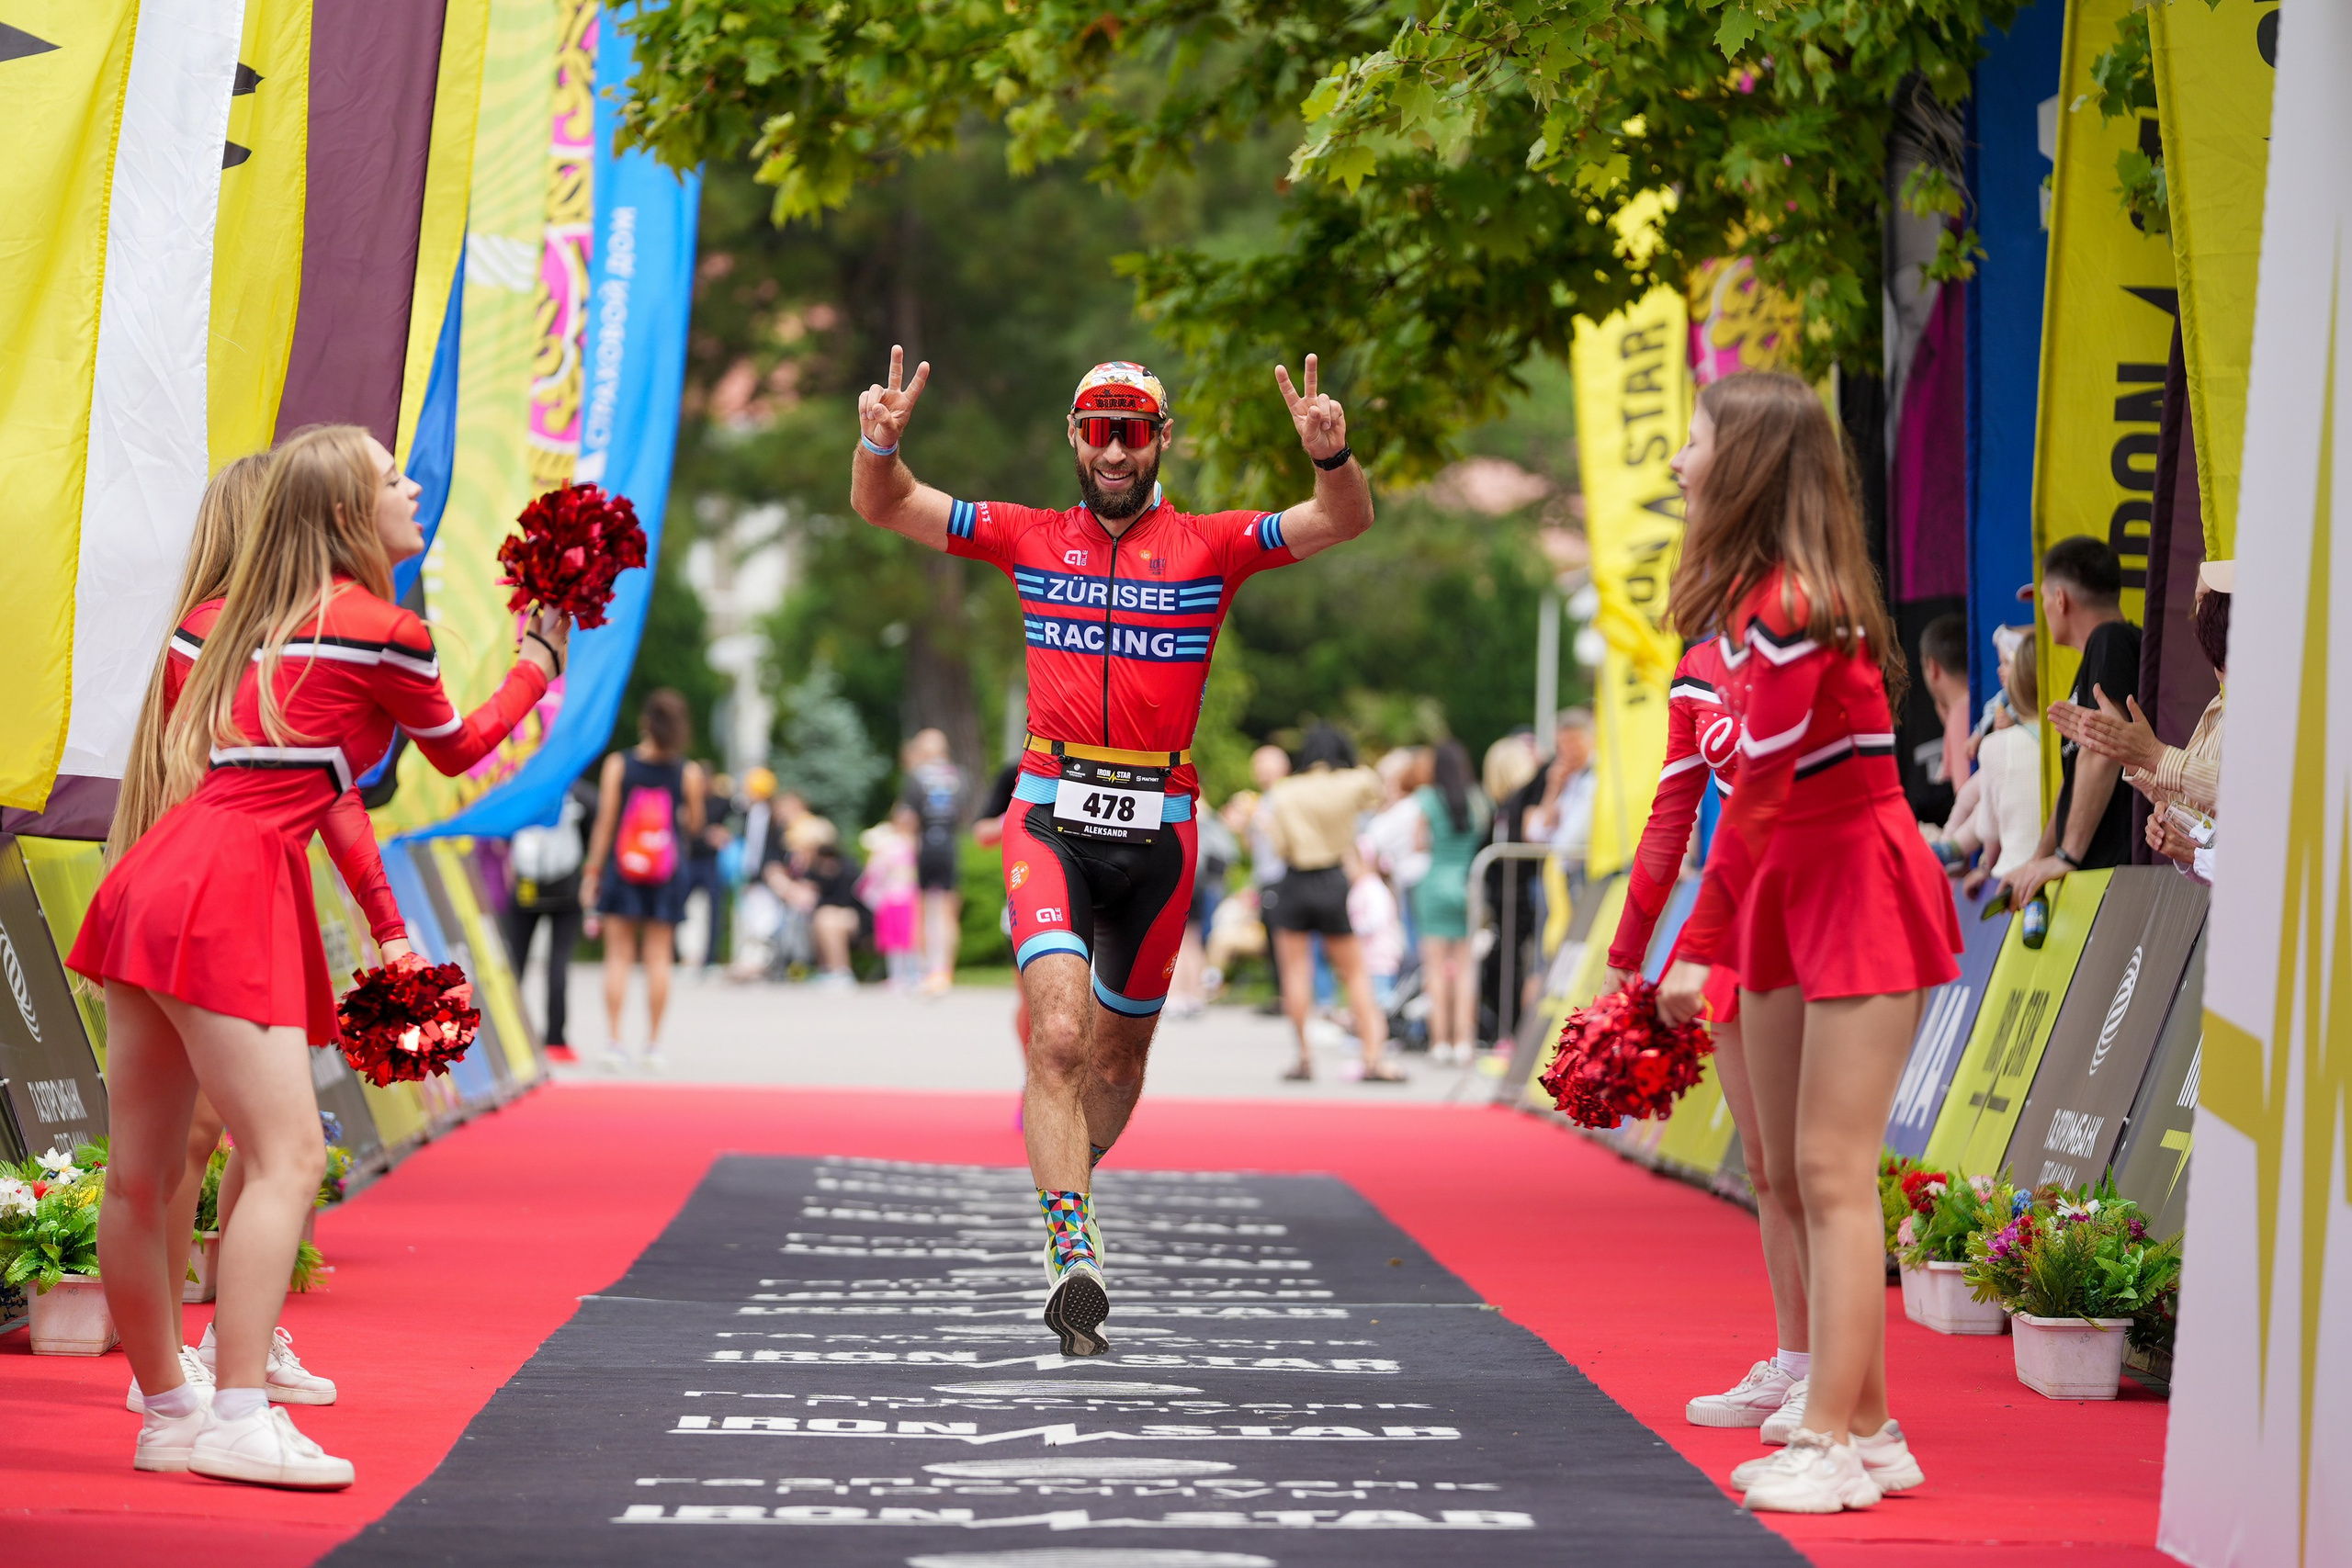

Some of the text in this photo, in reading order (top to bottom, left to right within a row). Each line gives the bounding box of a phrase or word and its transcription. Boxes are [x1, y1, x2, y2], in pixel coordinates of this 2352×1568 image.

[605, 206, 637, 277] ДОМ
[1620, 318, 1671, 468] STAR
[1046, 576, 1176, 611] ZÜRISEE
[1045, 621, 1175, 658] RACING
[1096, 768, 1112, 777] IRON
[1116, 771, 1132, 780] STAR
[1082, 792, 1136, 822] 478
[1084, 825, 1128, 838] ALEKSANDR
[711, 1349, 1401, 1371] IRON STAR
[676, 1415, 1463, 1438] IRON STAR
[621, 1504, 1535, 1527] IRON STAR
